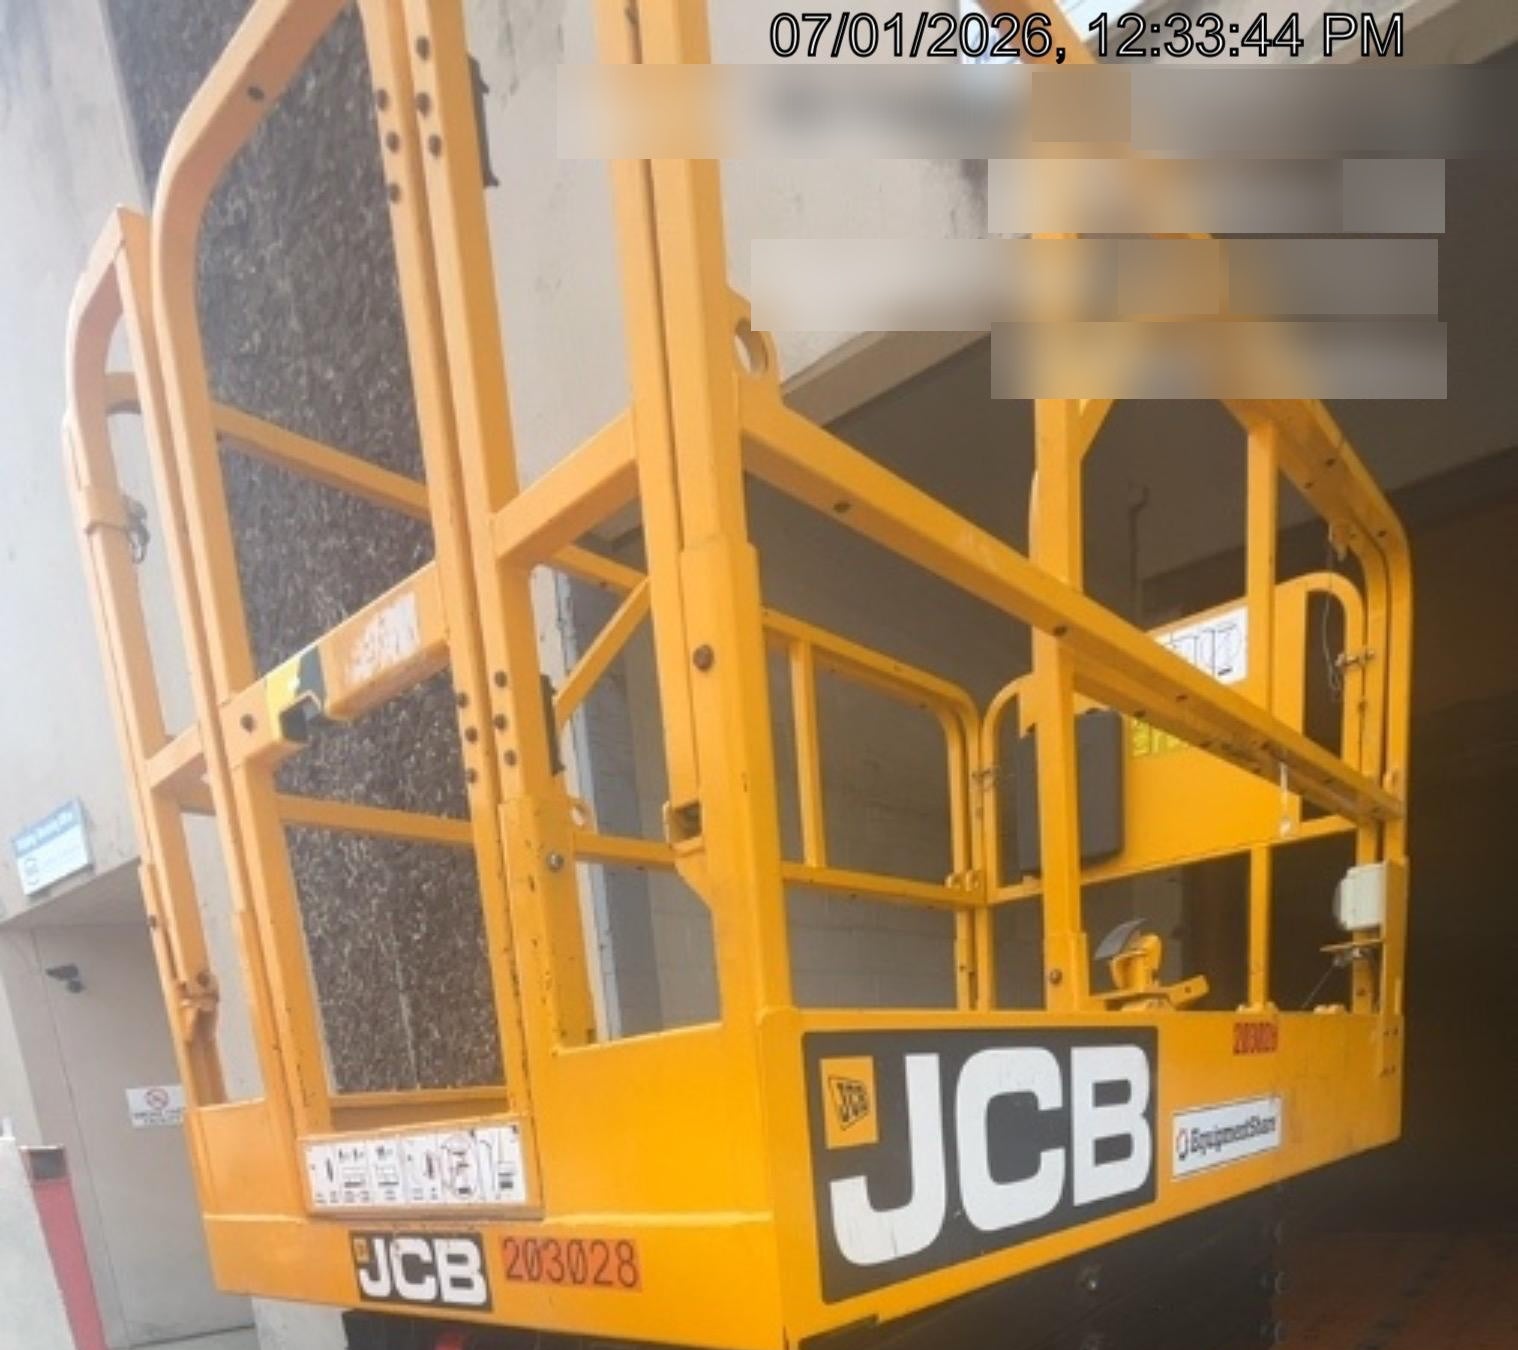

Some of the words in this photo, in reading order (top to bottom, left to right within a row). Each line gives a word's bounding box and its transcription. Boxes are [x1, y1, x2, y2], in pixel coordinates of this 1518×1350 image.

[830, 1043, 1152, 1266] JCB
[358, 1237, 488, 1306] JCB
[502, 1236, 640, 1289] 203028
